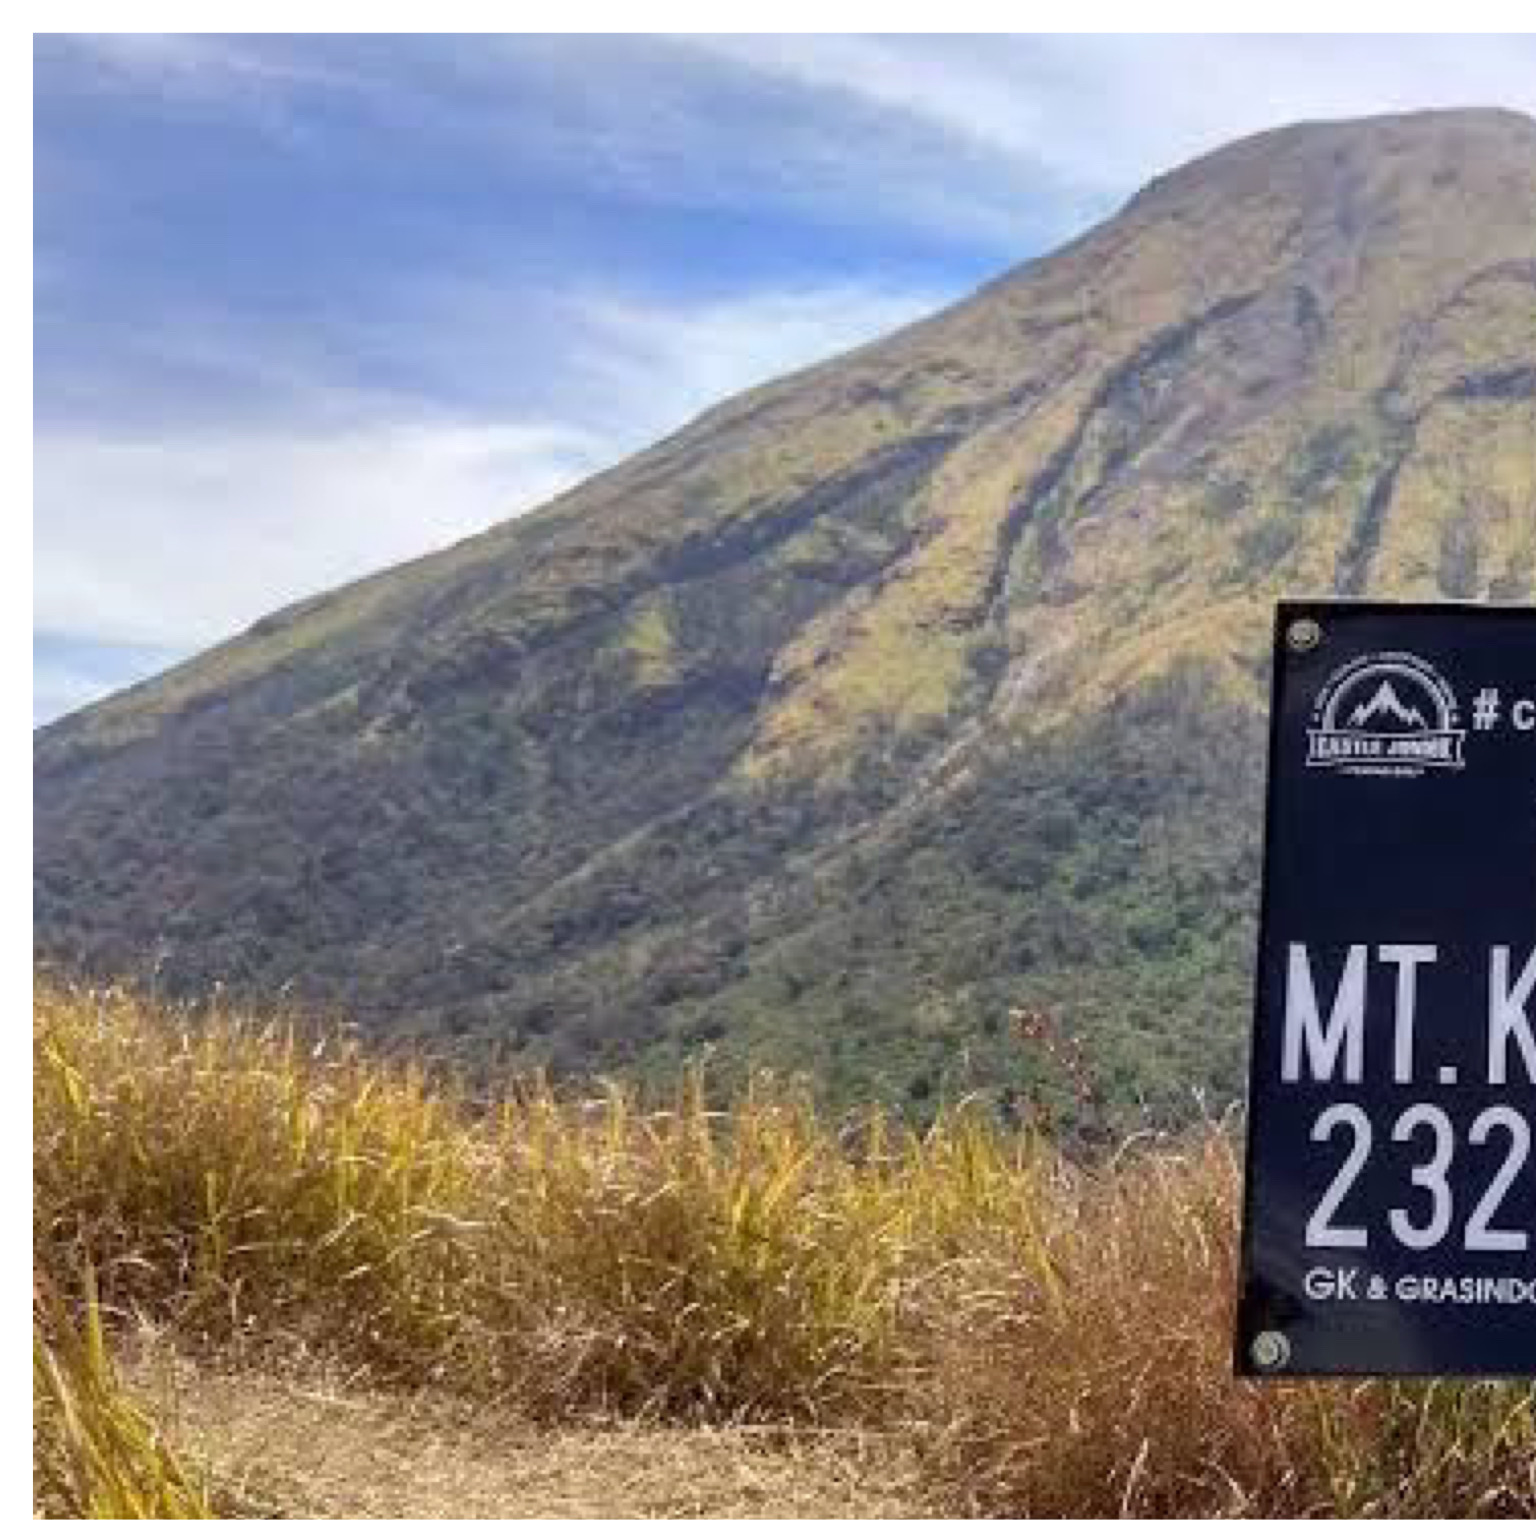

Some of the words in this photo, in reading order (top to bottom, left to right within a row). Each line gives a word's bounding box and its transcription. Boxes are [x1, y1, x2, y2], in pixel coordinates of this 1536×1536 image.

[1472, 686, 1500, 732] #
[1280, 942, 1458, 1085] MT.
[1302, 1264, 1360, 1302] GK
[1366, 1273, 1388, 1301] &
